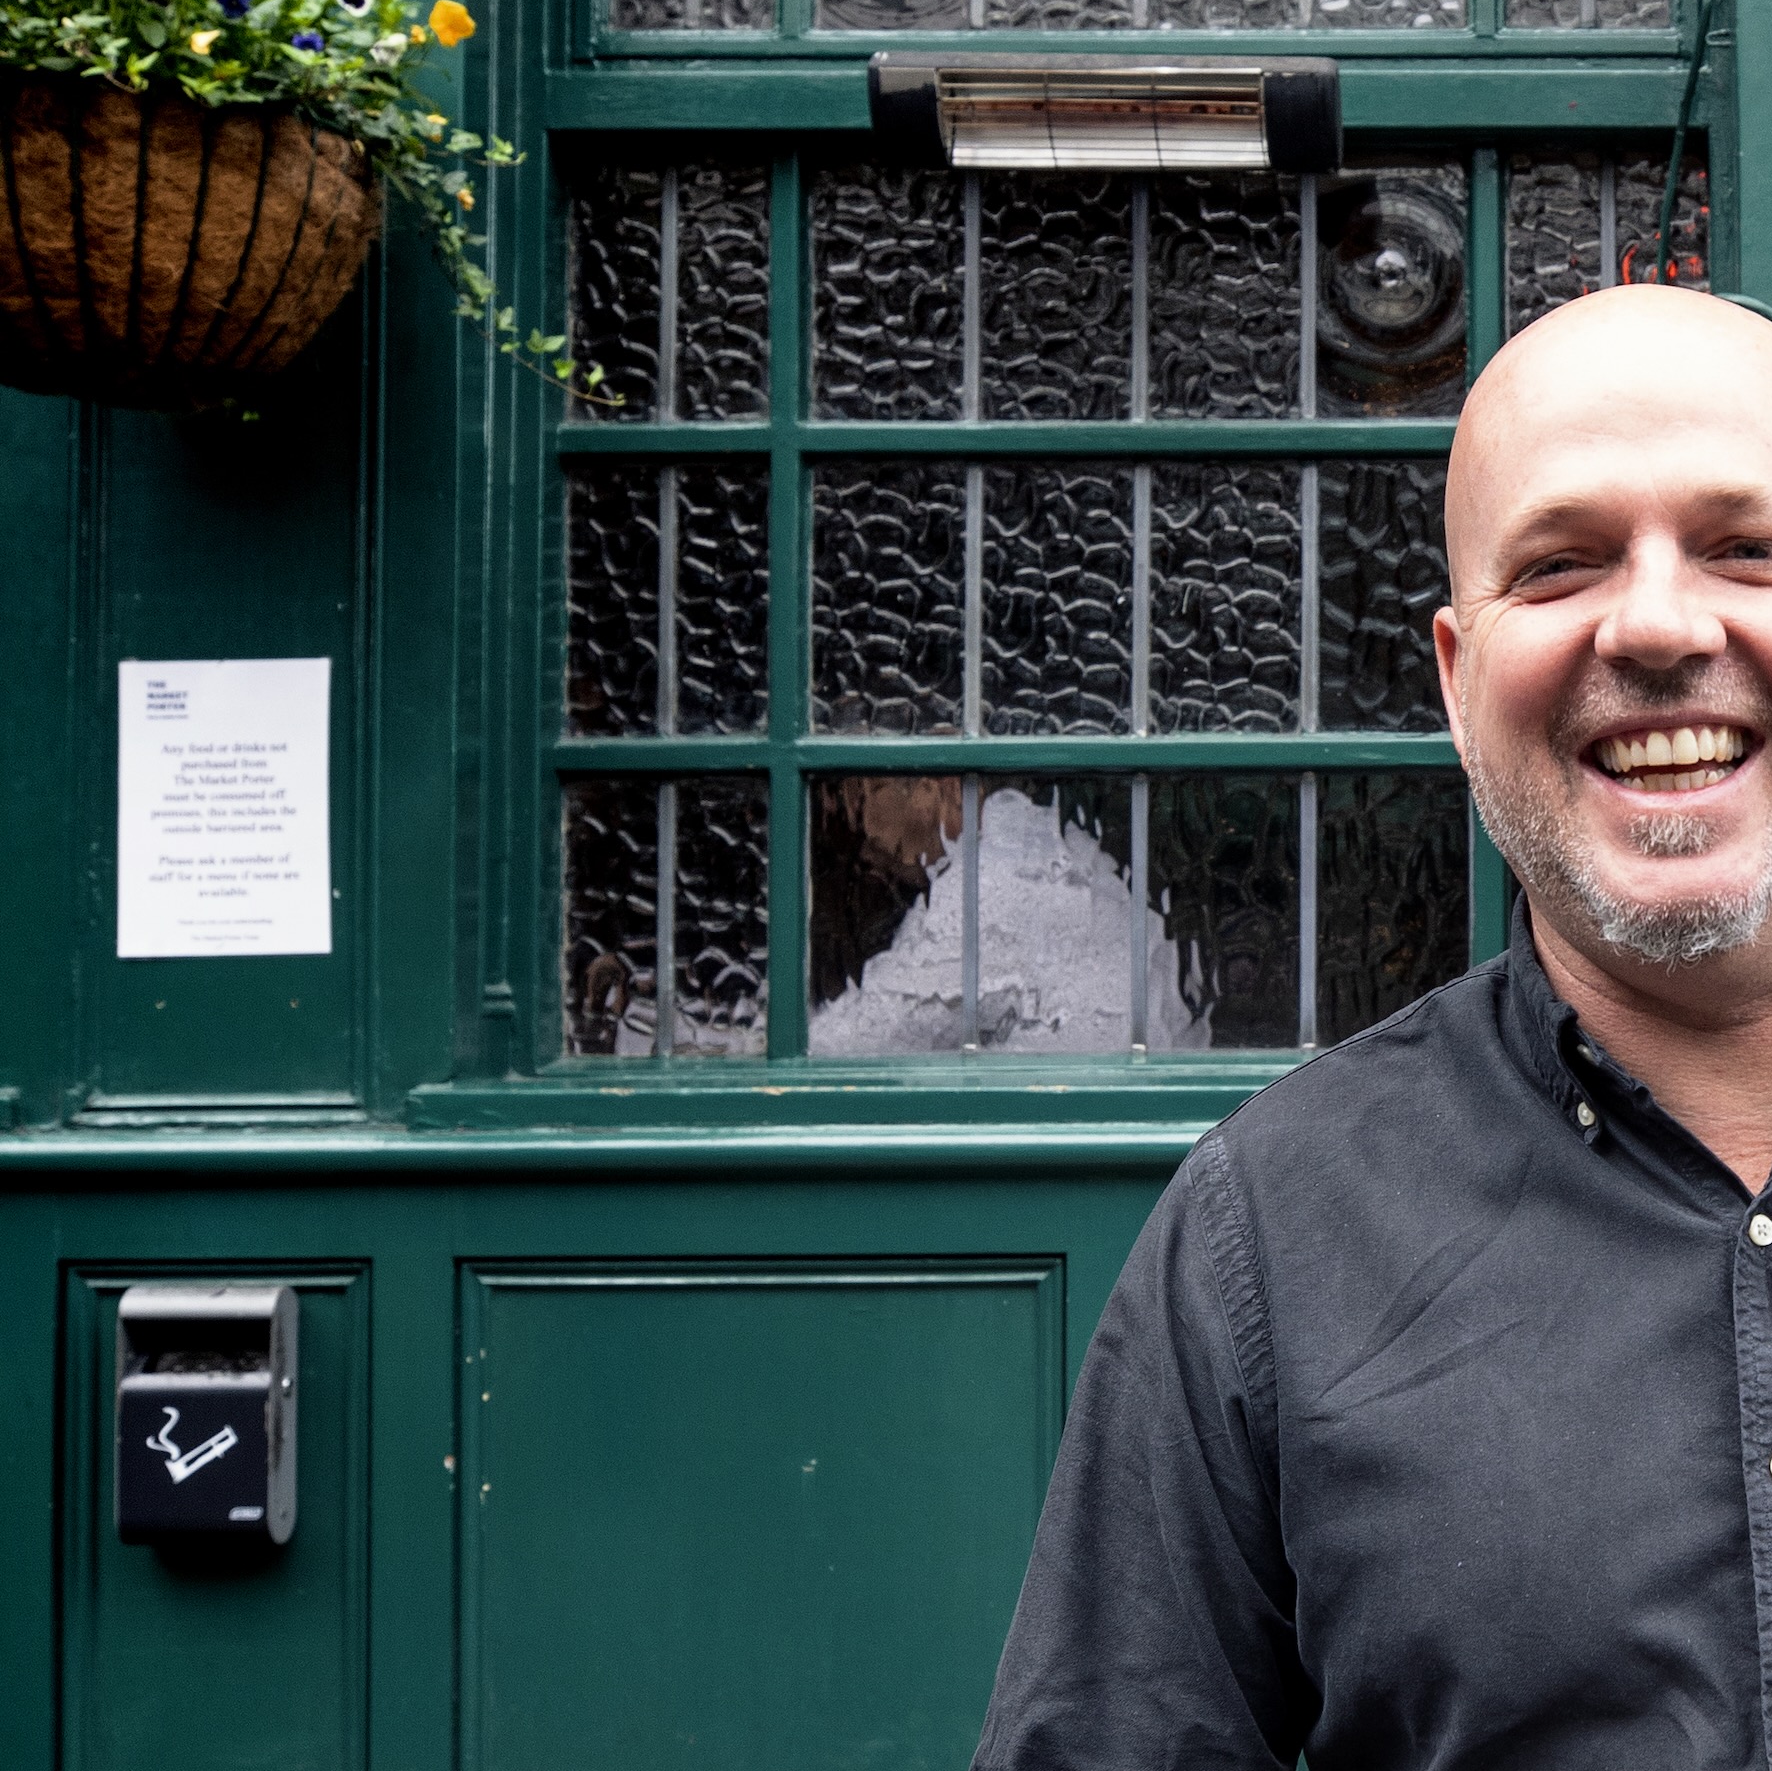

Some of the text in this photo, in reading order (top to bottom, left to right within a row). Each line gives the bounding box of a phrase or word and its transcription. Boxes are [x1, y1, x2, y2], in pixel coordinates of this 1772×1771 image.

[189, 743, 214, 754] food
[232, 742, 266, 753] drinks
[199, 774, 237, 784] Market
